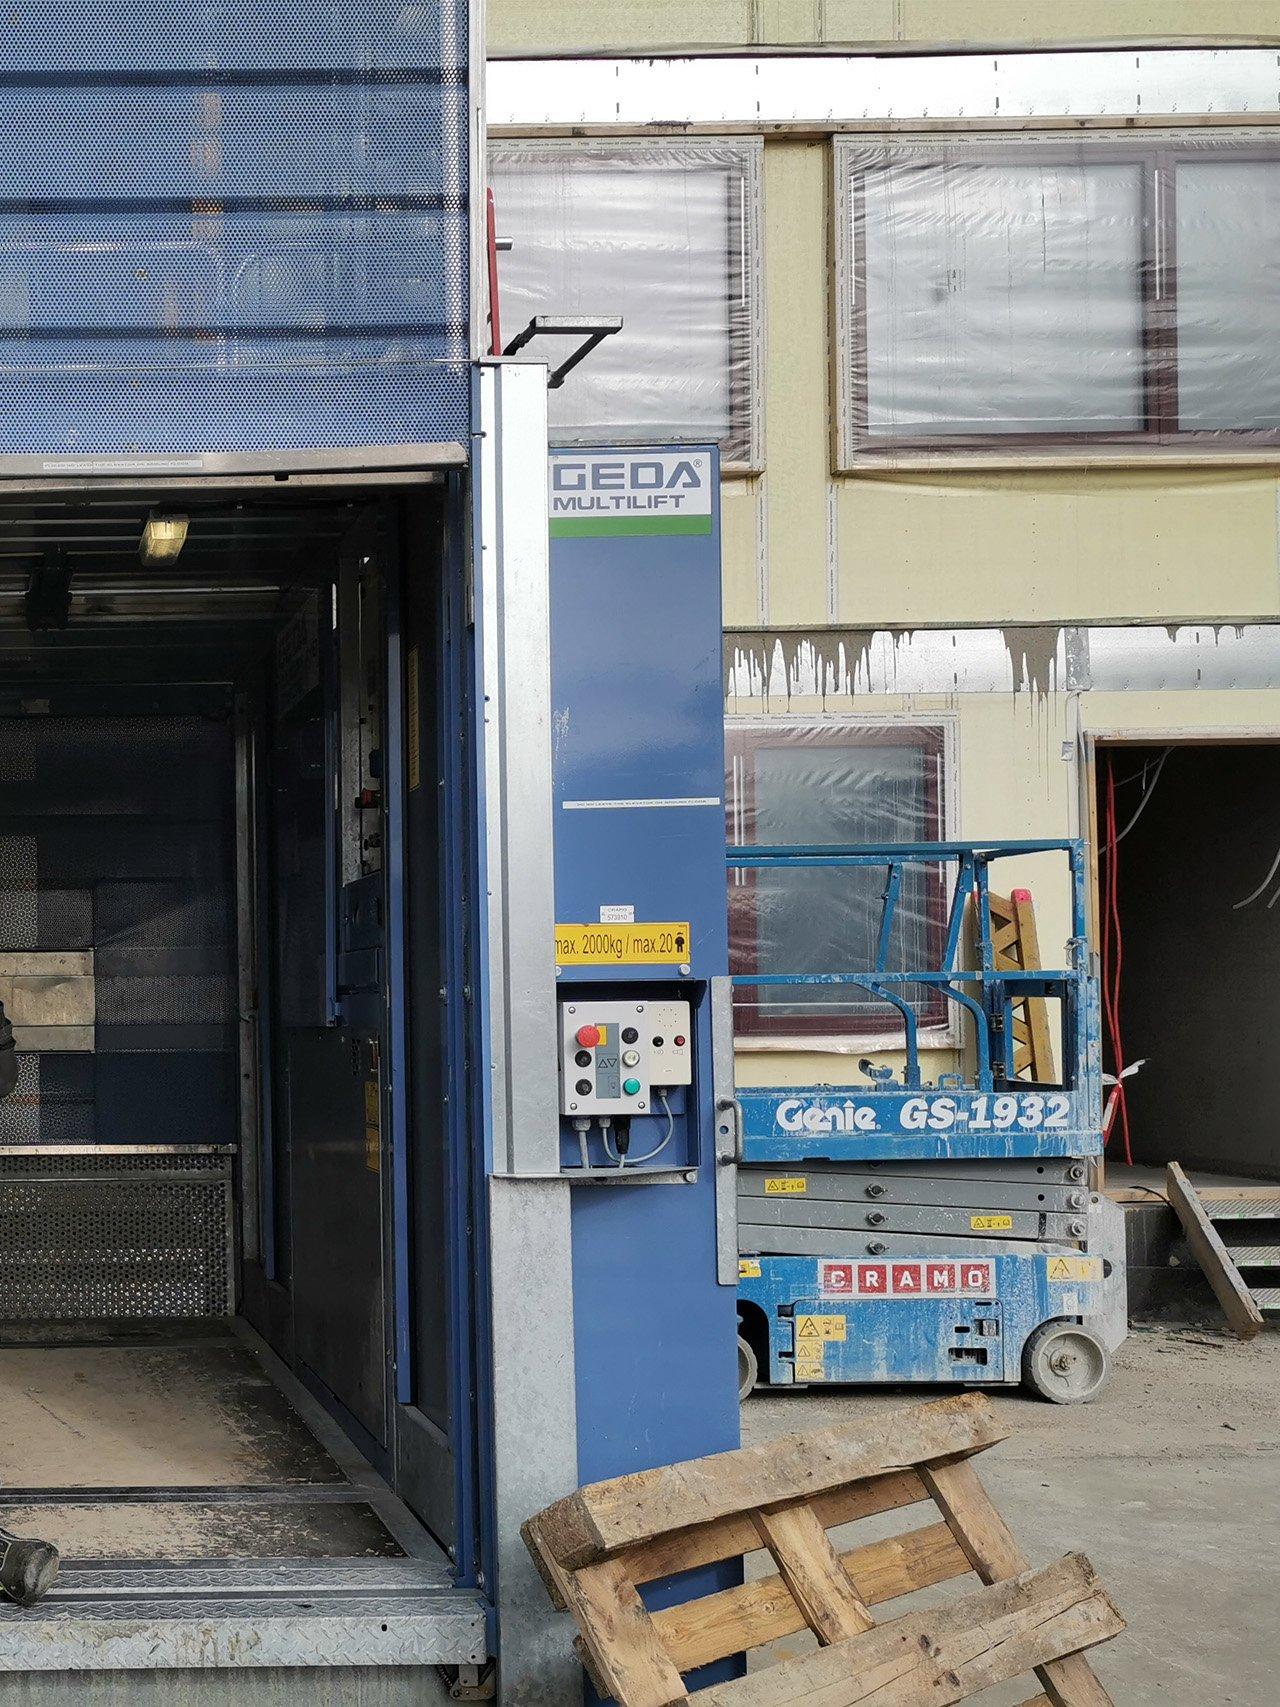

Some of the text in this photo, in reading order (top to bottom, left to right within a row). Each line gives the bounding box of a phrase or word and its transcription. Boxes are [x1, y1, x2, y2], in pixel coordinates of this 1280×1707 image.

[552, 461, 702, 491] GEDA
[552, 494, 686, 511] MULTILIFT
[582, 934, 623, 959] 2000kg
[775, 1097, 1071, 1131] Genie GS-1932
[829, 1269, 984, 1288] CRAMO
